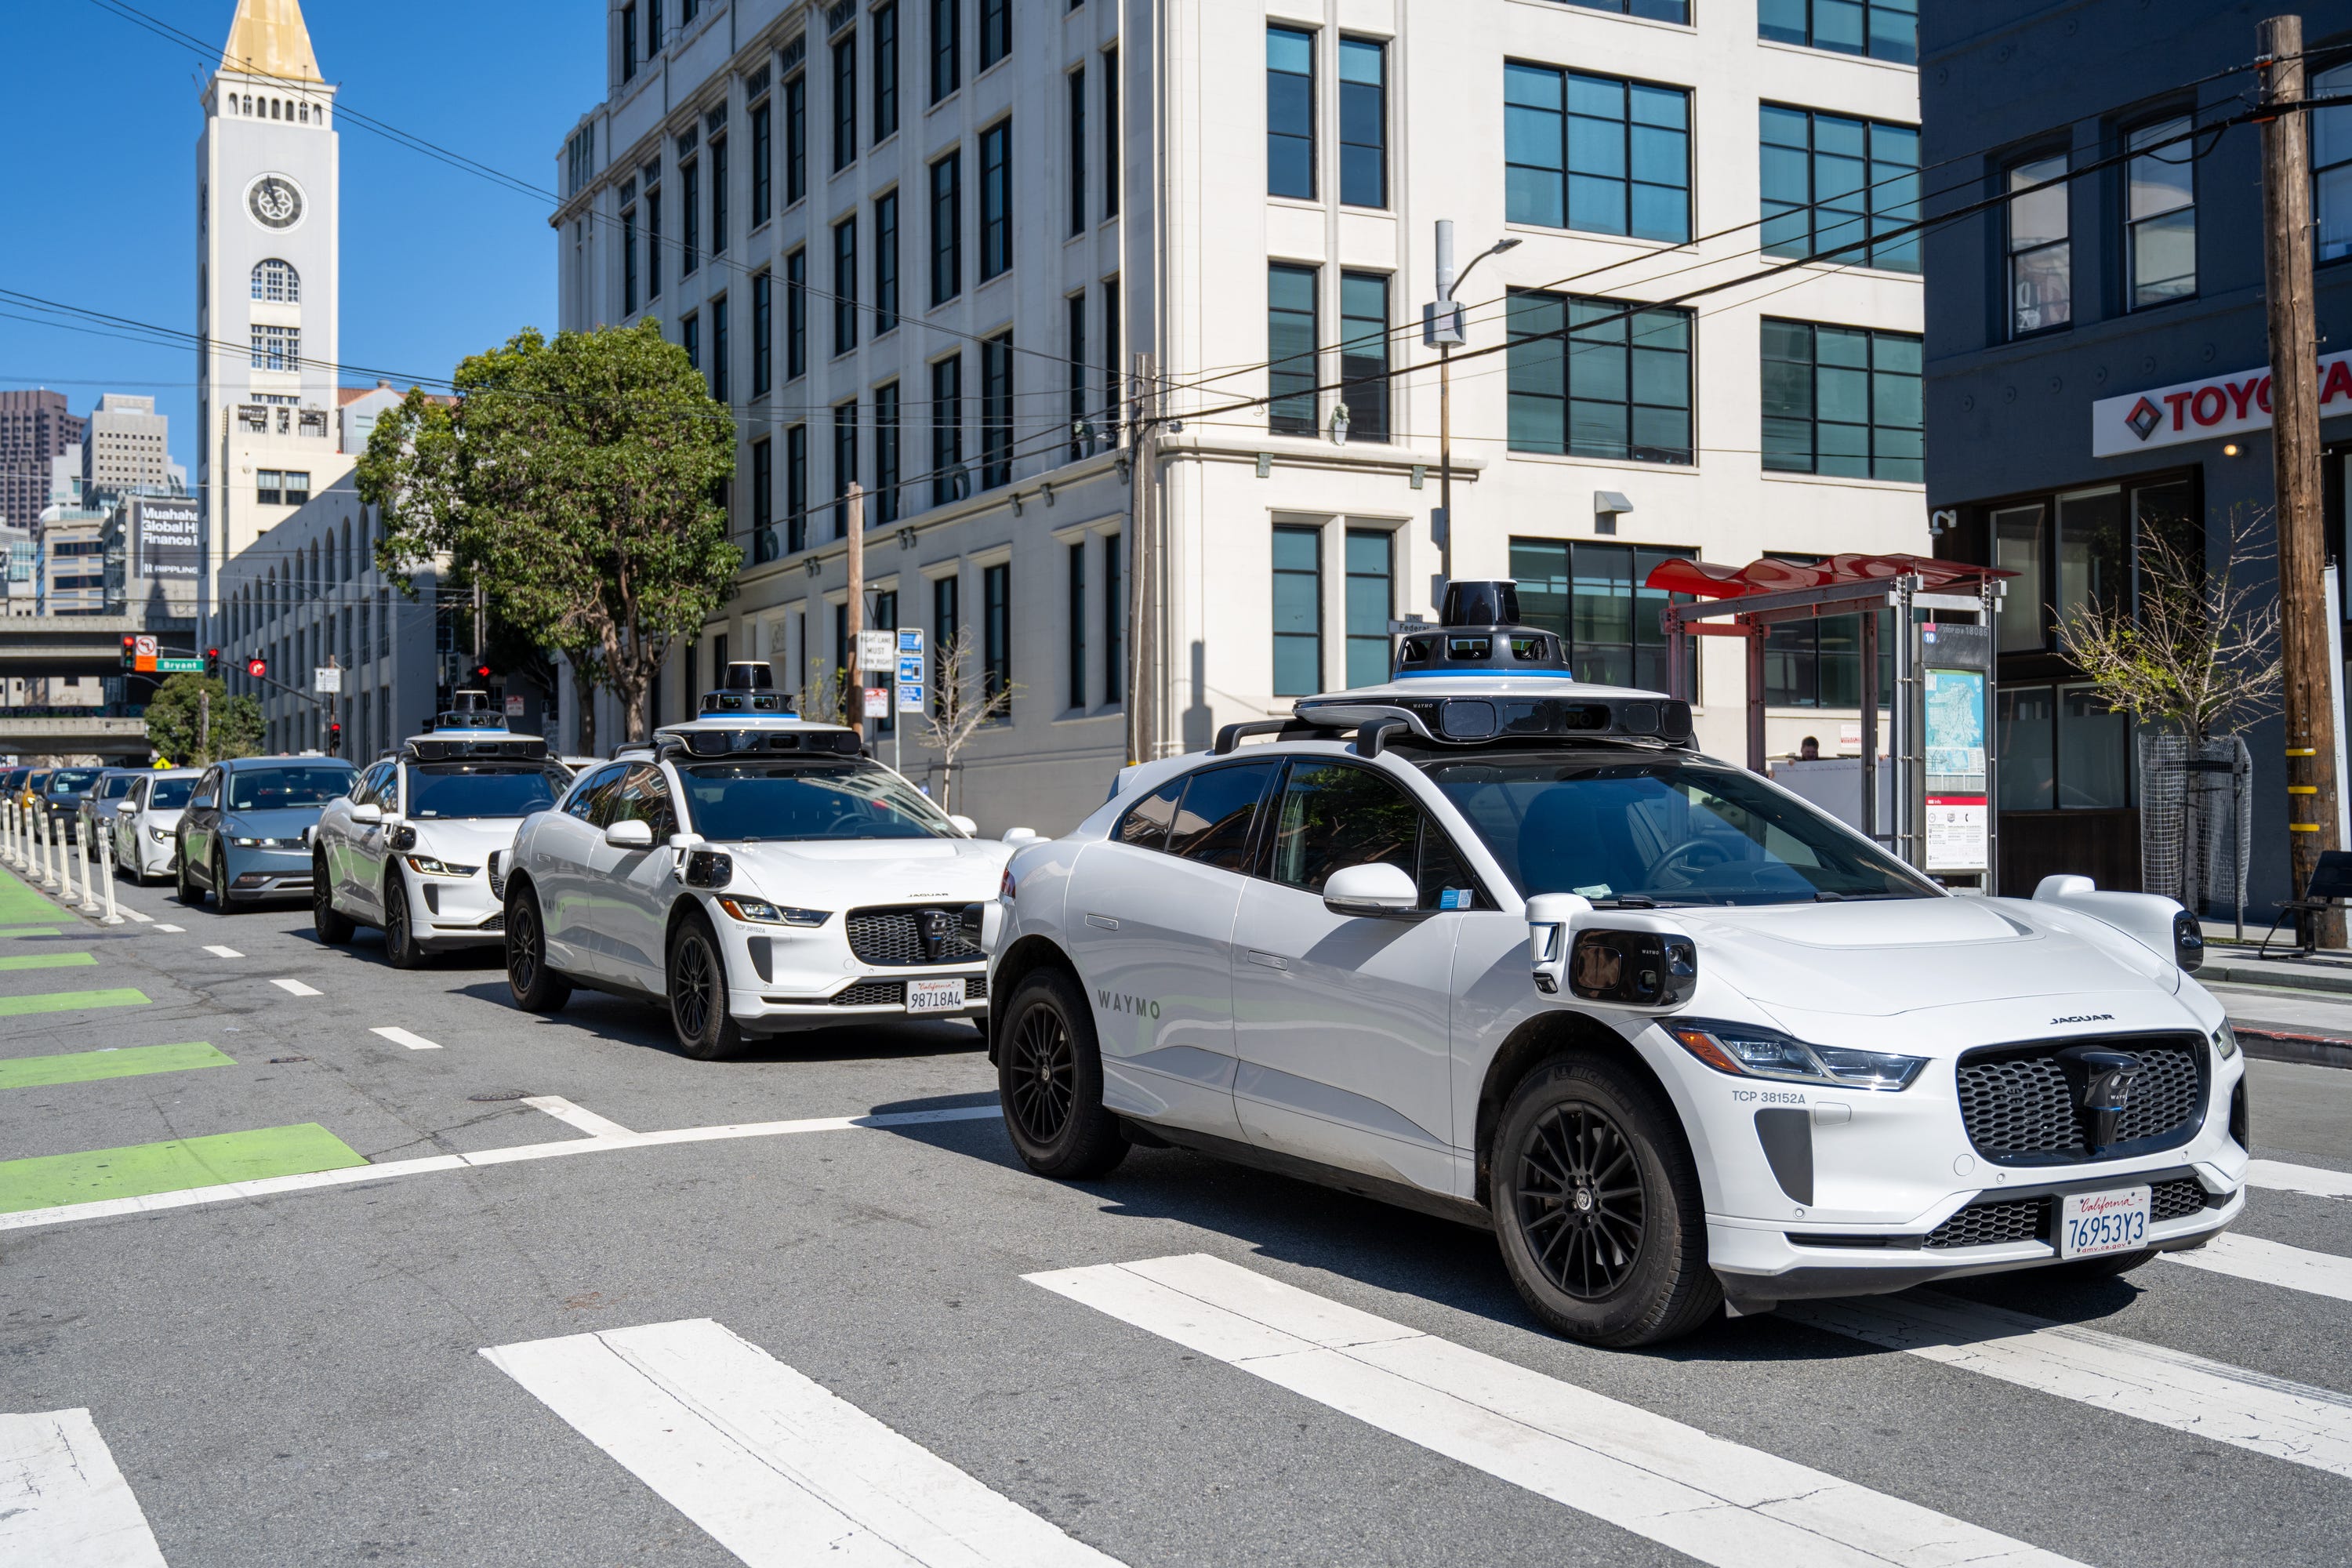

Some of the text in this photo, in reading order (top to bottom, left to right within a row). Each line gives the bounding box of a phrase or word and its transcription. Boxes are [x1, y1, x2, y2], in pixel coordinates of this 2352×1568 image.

[2164, 361, 2352, 430] TOYA
[143, 520, 183, 532] Global
[143, 532, 192, 546] Finance
[154, 565, 198, 574] RIPPLING
[1926, 633, 1934, 642] 10
[1965, 626, 1988, 637] 18086
[163, 661, 197, 670] Bryant
[911, 990, 961, 1008] 98718A4
[1098, 989, 1160, 1019] WAYMO
[2050, 1014, 2115, 1025] JAGUAR
[1732, 1091, 1806, 1104] TCP 38152A
[2082, 1196, 2134, 1214] California
[2069, 1211, 2144, 1248] 76953Y3
[2082, 1242, 2126, 1253] dmv.ca.gov
